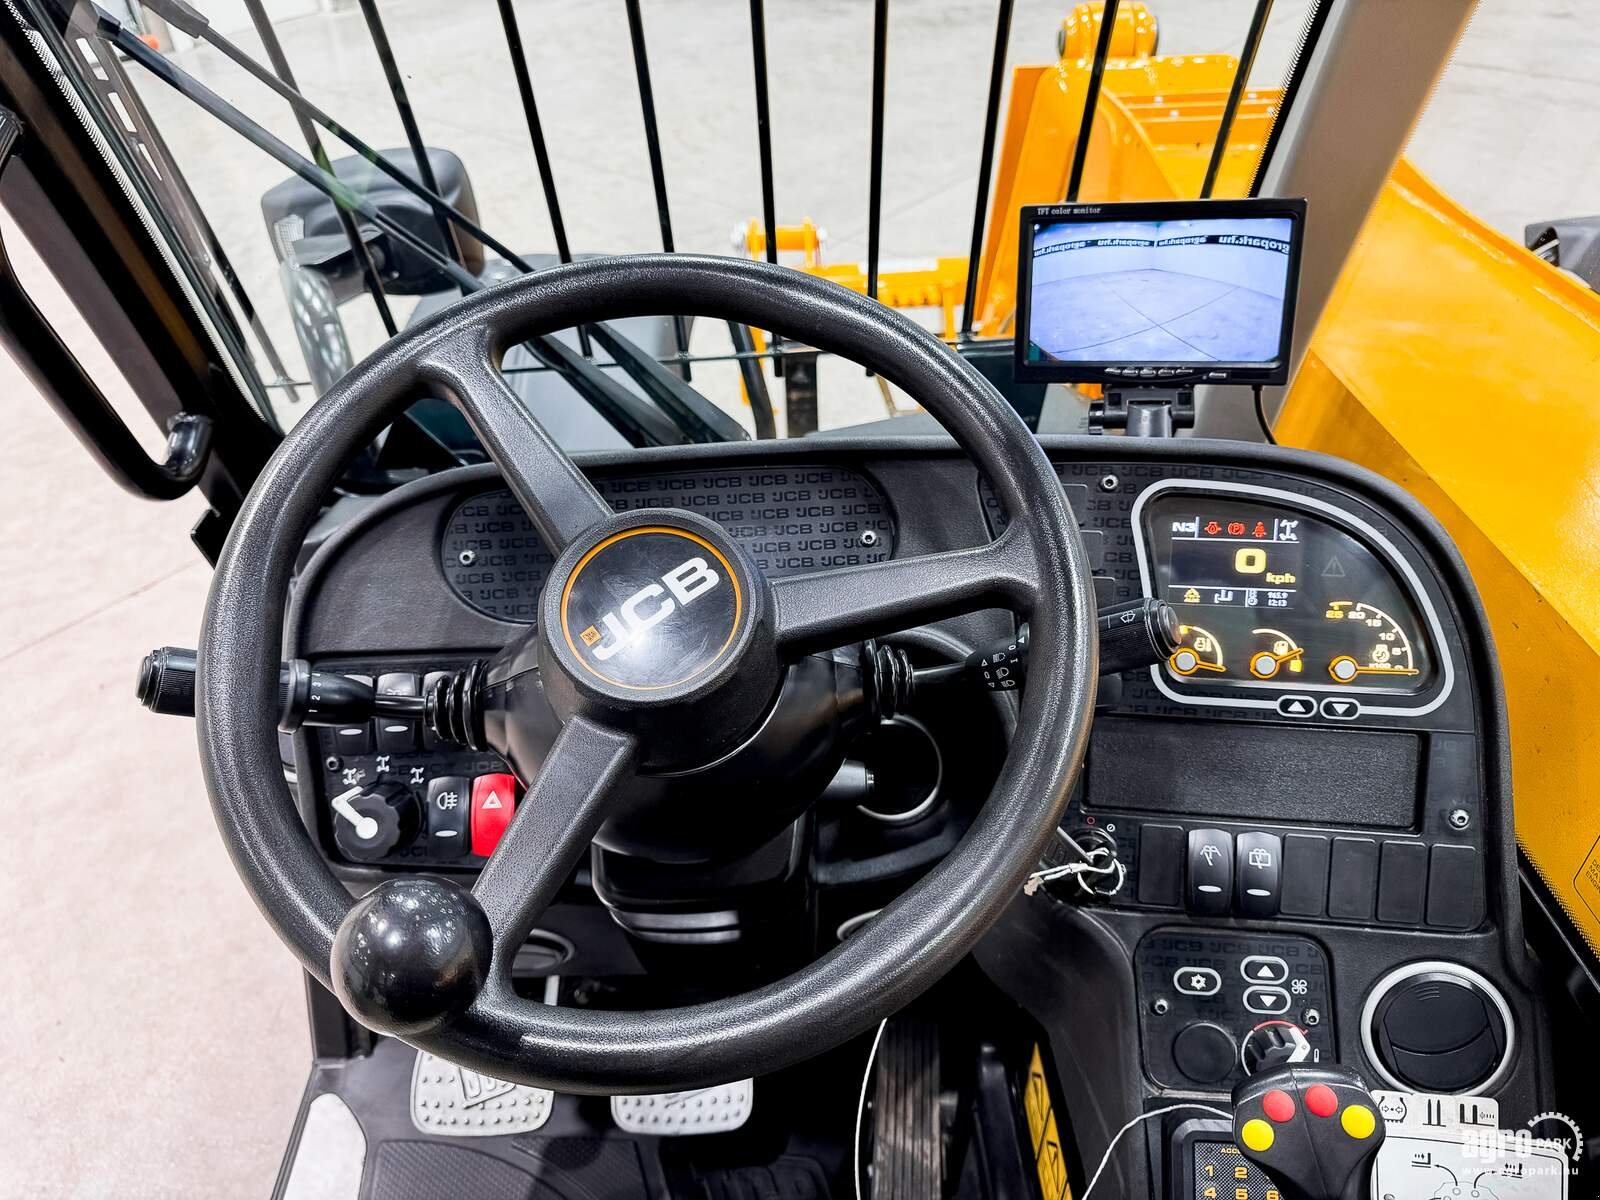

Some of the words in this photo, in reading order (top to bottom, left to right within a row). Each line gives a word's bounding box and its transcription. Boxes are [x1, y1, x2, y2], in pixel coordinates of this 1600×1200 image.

[1037, 208, 1050, 216] TFT
[704, 476, 742, 489] JCB
[749, 474, 787, 487] JCB
[795, 472, 833, 485] JCB
[681, 495, 719, 507] JCB
[727, 493, 765, 505] JCB
[772, 490, 811, 503] JCB
[818, 487, 857, 500] JCB
[751, 508, 789, 520] JCB
[796, 506, 834, 518] JCB
[842, 503, 881, 516] JCB
[475, 521, 514, 533] JCB
[775, 524, 813, 537] JCB
[819, 522, 858, 535] JCB
[865, 520, 889, 532] JC
[1172, 522, 1195, 533] N3
[798, 538, 837, 551] JCB
[776, 557, 814, 570] JCB
[821, 555, 859, 567] JCB
[1235, 548, 1267, 574] 0
[455, 572, 494, 584] JCB
[1266, 572, 1296, 585] kph
[580, 557, 720, 661] JCB
[1326, 610, 1344, 619] 25
[1347, 611, 1366, 619] 20
[1365, 619, 1382, 627] 15
[1378, 632, 1396, 641] 10
[1391, 647, 1402, 655] 5
[1204, 1165, 1214, 1177] 1
[1234, 1166, 1248, 1179] 2
[1203, 1186, 1217, 1199] 4
[1235, 1187, 1248, 1200] 5
